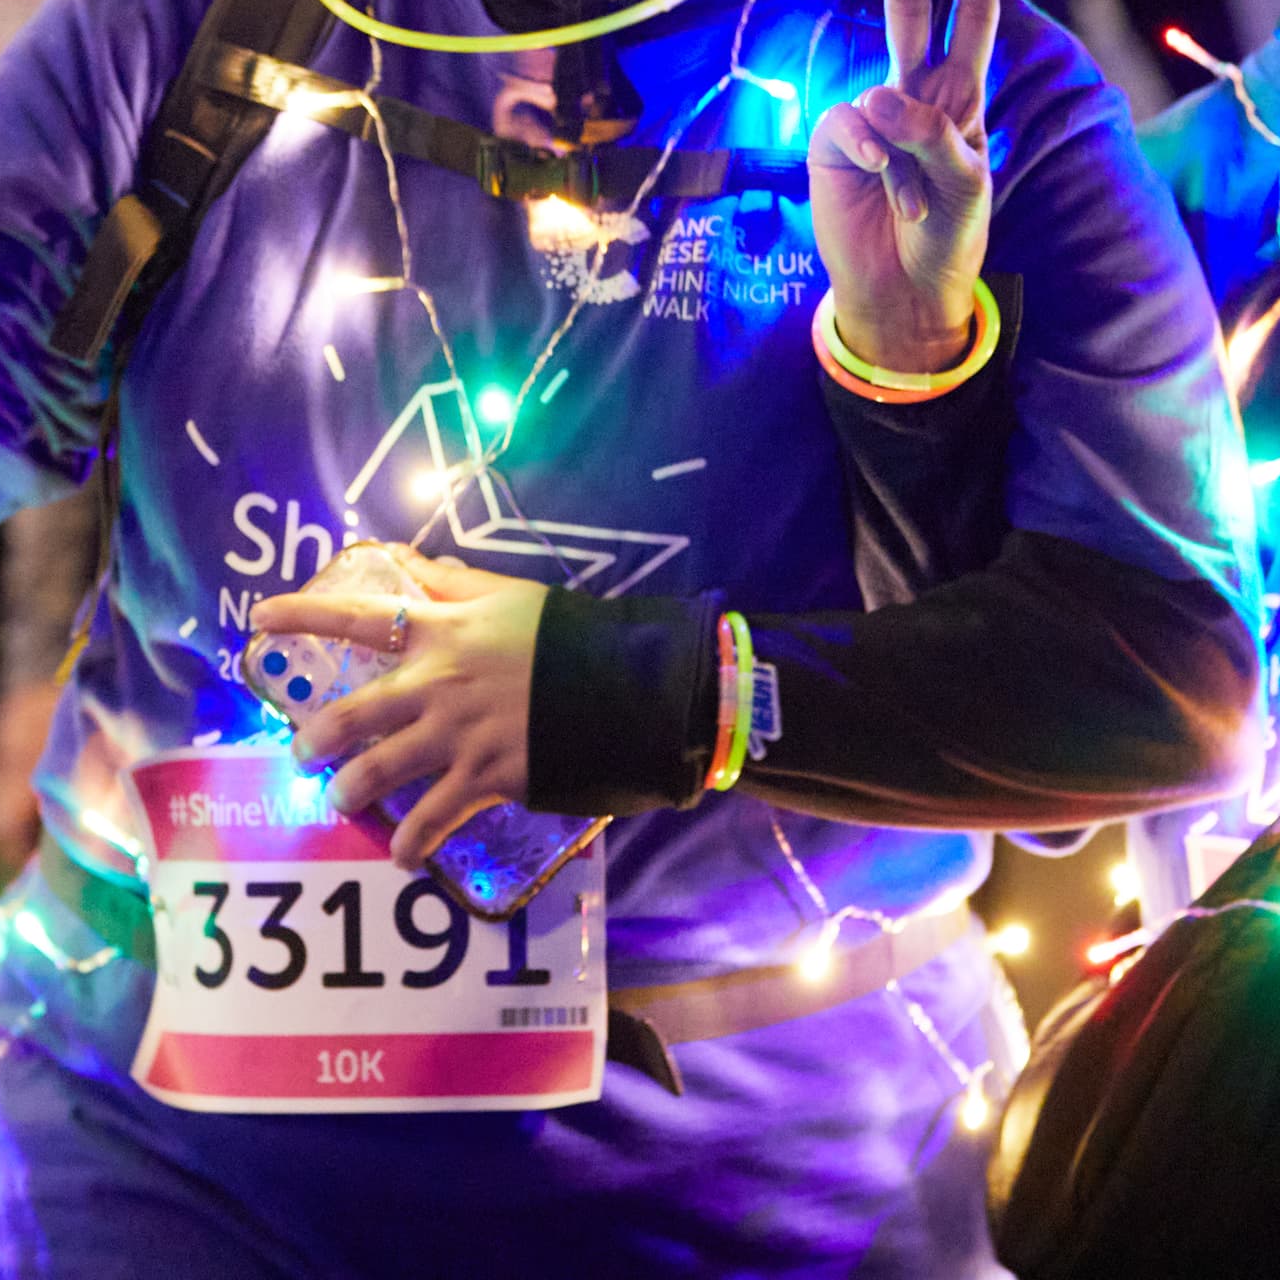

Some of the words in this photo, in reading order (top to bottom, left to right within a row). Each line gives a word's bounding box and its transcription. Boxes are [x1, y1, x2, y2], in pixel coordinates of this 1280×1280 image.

[664, 215, 747, 248] ANCER
[778, 252, 814, 276] UK
[723, 280, 807, 306] NIGHT
[643, 294, 710, 322] WALK
[316, 1050, 385, 1084] 10K
